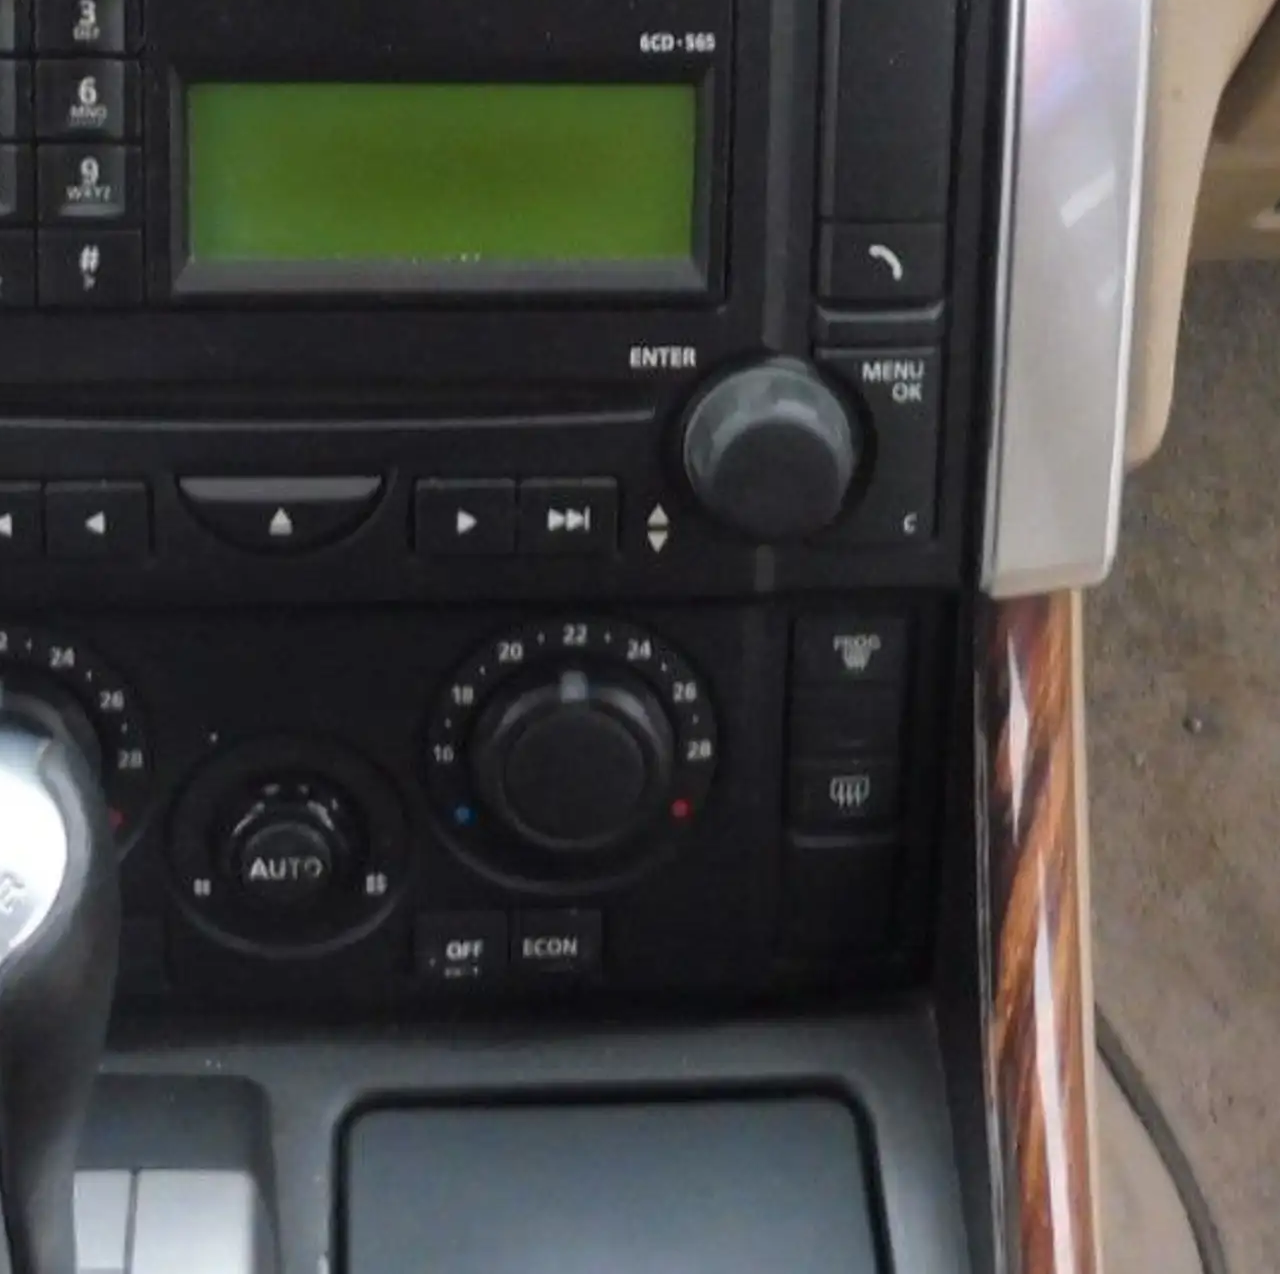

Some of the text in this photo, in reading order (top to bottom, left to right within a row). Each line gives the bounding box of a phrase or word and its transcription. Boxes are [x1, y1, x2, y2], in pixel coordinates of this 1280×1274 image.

[78, 75, 98, 105] 6
[80, 156, 100, 185] 9
[629, 346, 697, 368] ENTER
[861, 358, 924, 382] MENU
[892, 381, 923, 403] OK
[561, 622, 588, 646] 22
[497, 641, 524, 664] 20
[249, 856, 323, 881] AUTO
[445, 938, 485, 961] OFF
[523, 936, 578, 959] ECON
